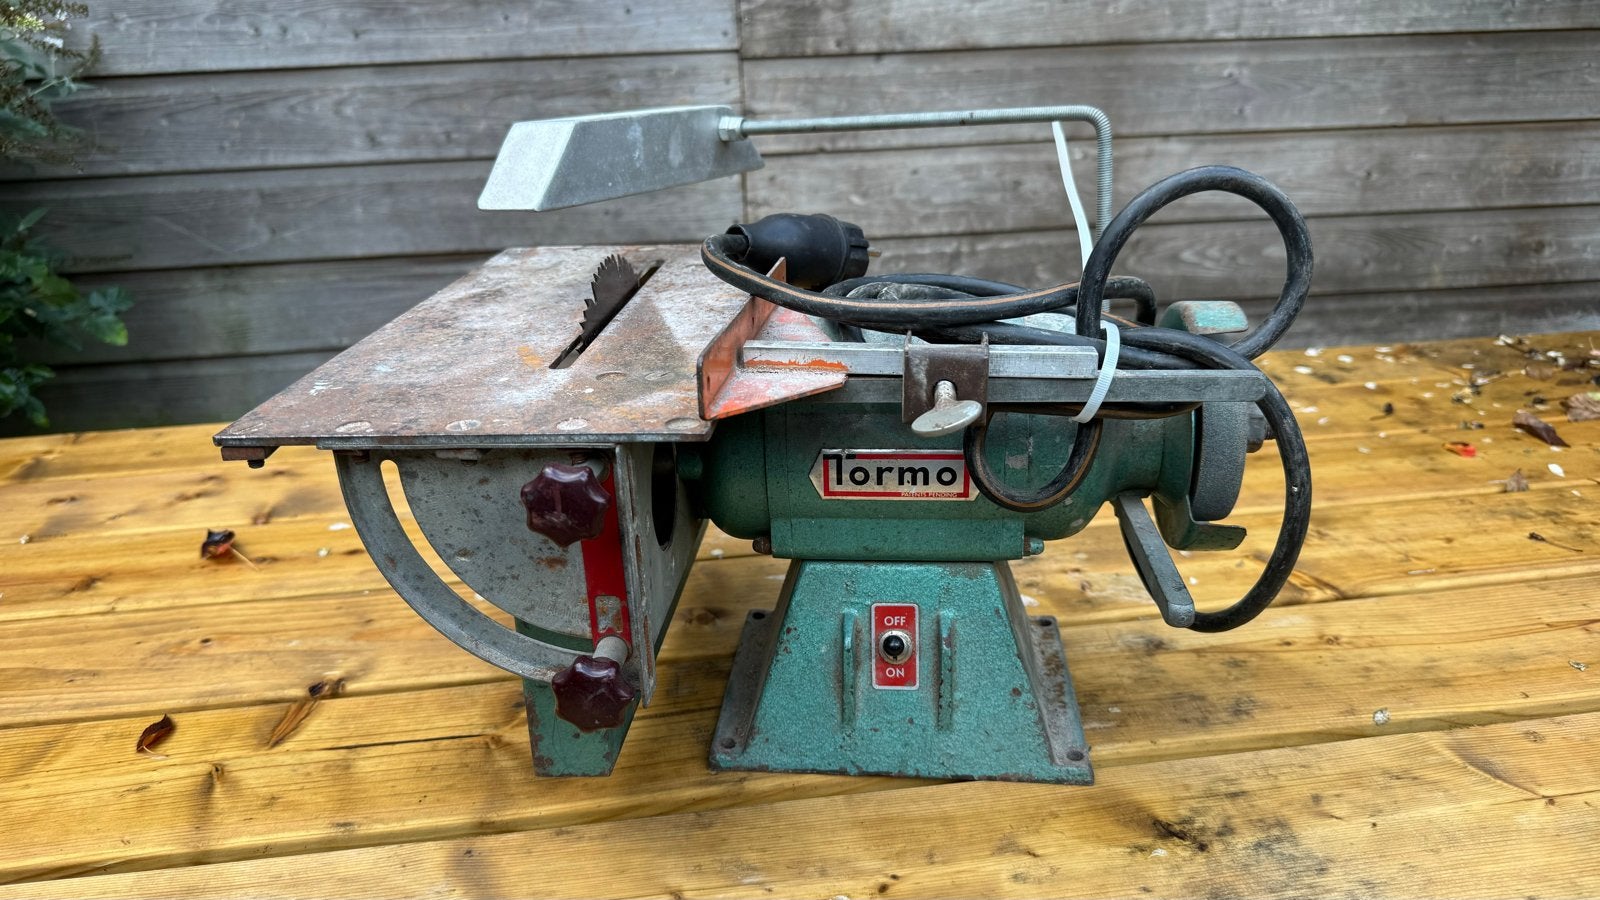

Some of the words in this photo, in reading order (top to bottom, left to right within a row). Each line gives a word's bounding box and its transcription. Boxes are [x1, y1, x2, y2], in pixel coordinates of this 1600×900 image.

[823, 454, 957, 486] Tormo
[884, 616, 906, 626] OFF
[885, 667, 905, 678] ON
